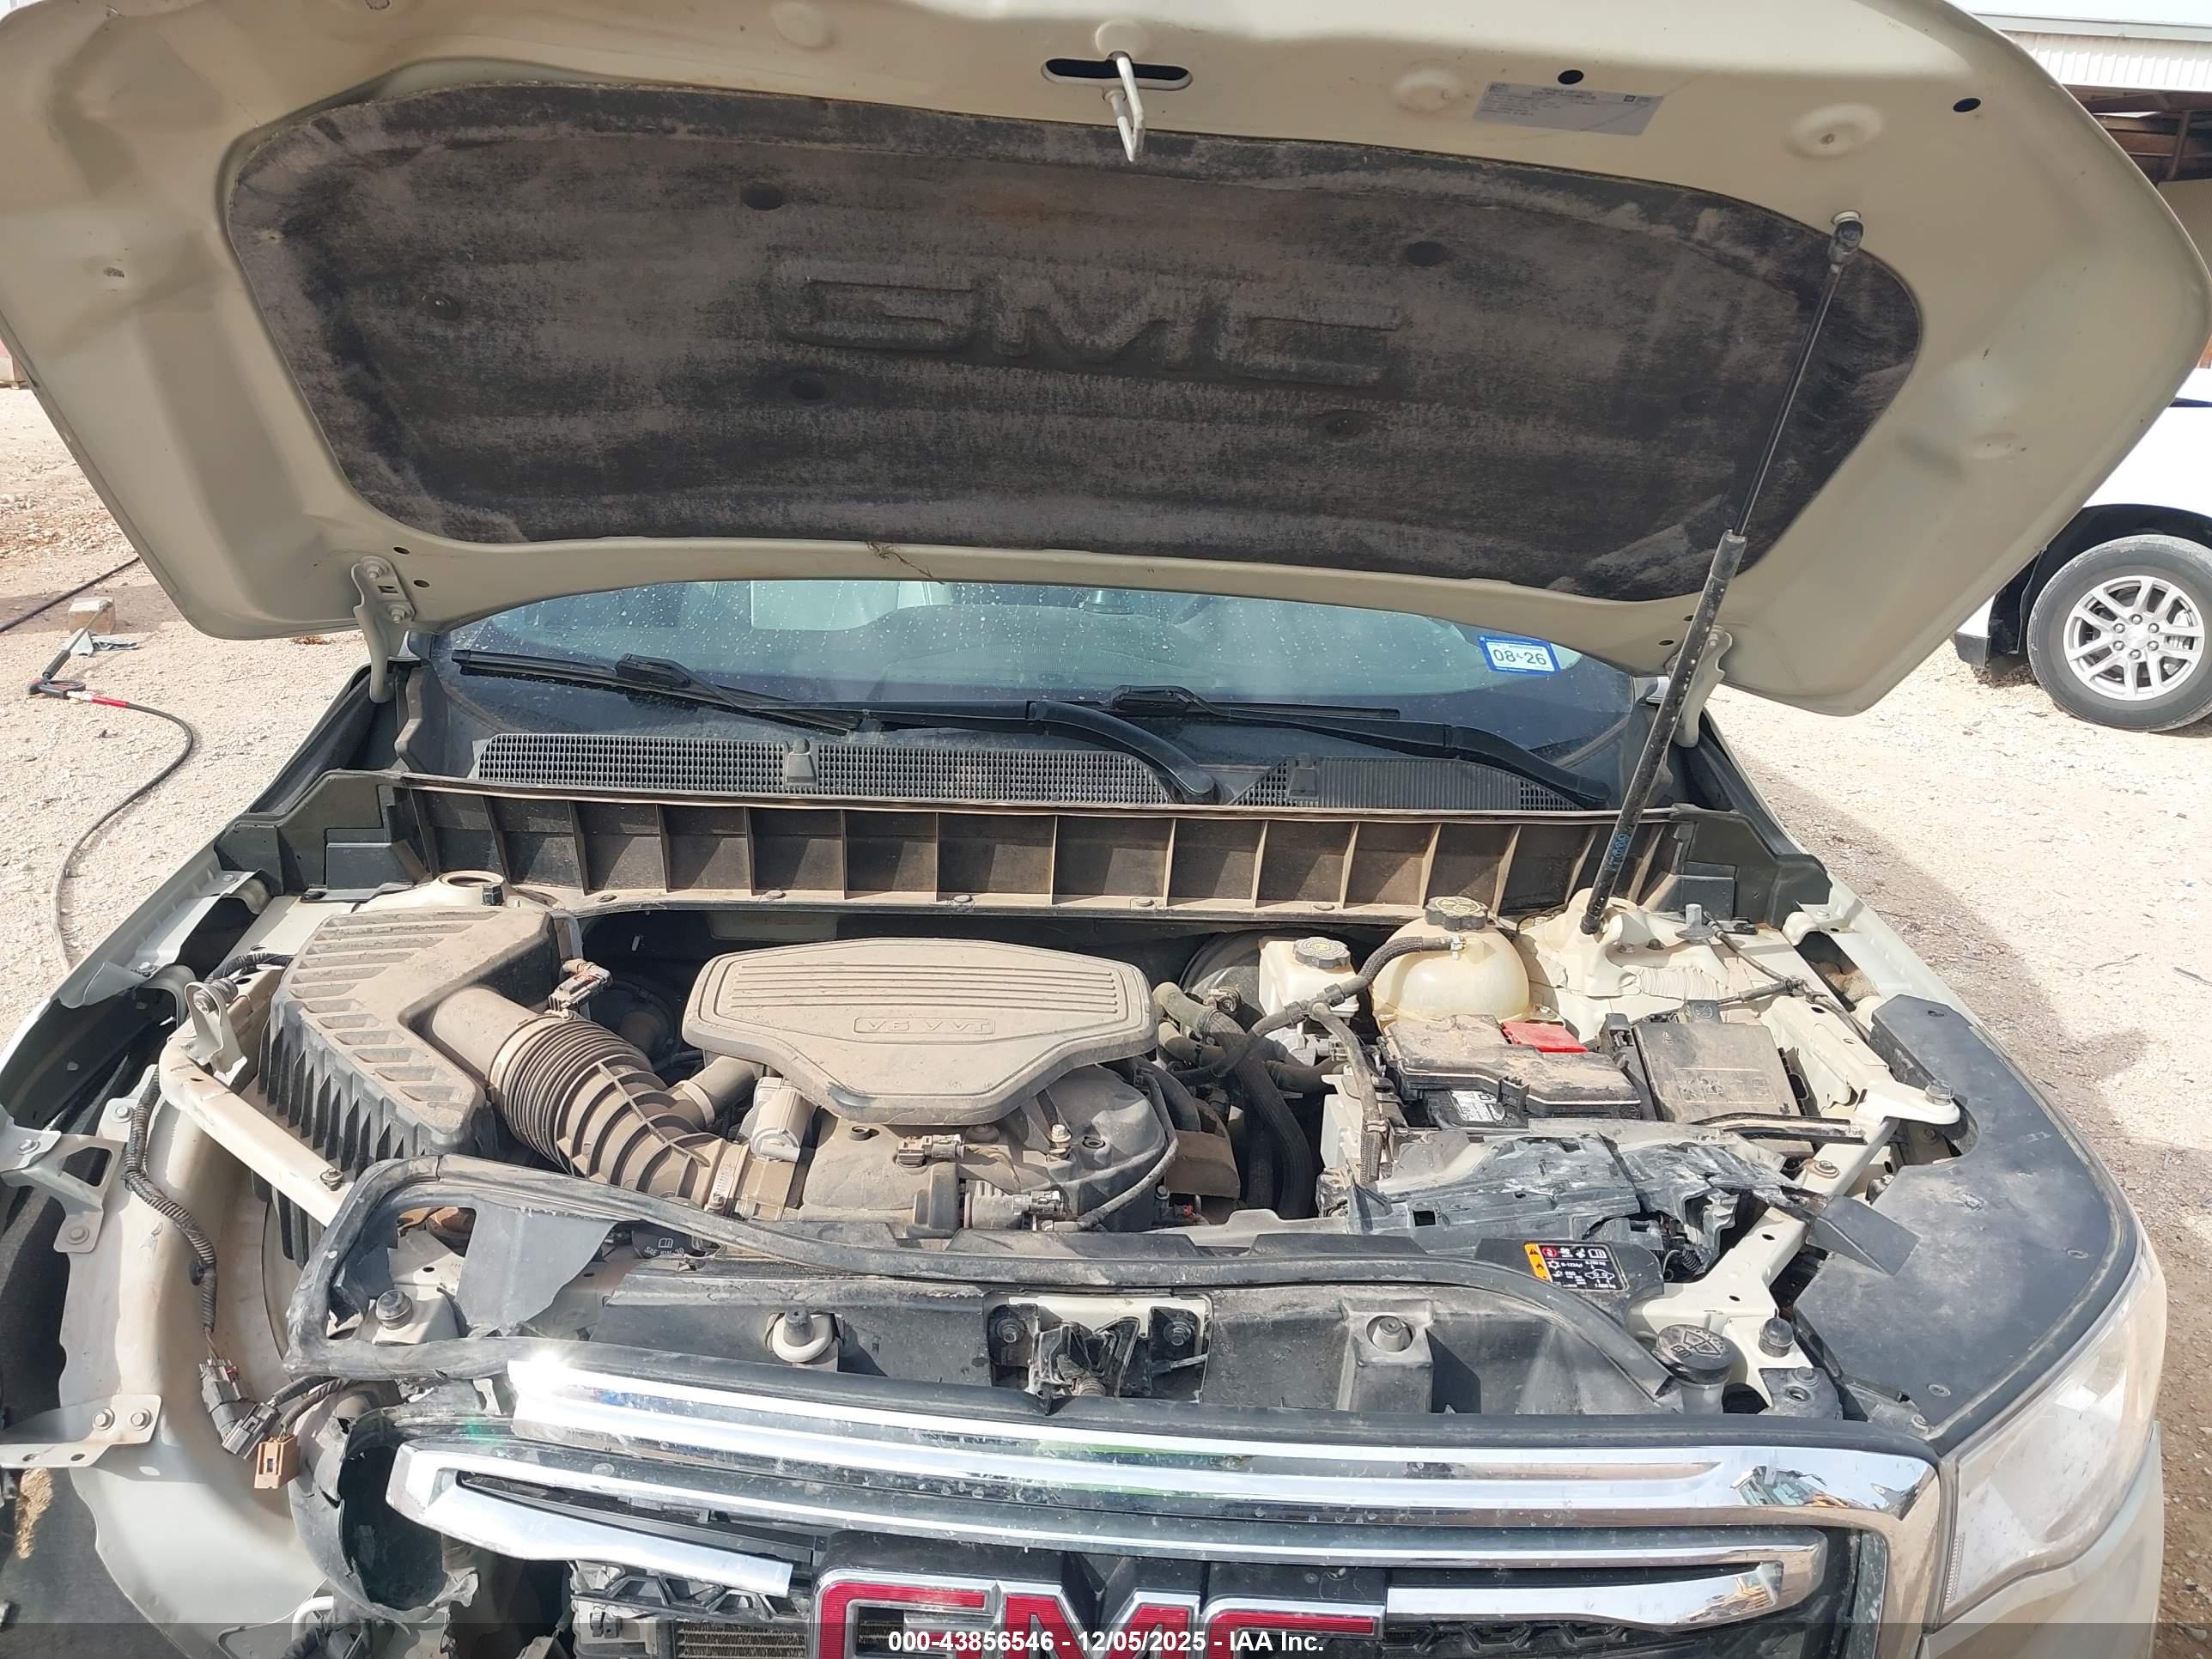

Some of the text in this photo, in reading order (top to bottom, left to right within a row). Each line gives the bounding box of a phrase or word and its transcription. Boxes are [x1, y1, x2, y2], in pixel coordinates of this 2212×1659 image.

[775, 261, 1403, 386] GMC
[1493, 648, 1547, 665] 08 26
[644, 1246, 659, 1256] SAE
[814, 1567, 1386, 1659] GMC
